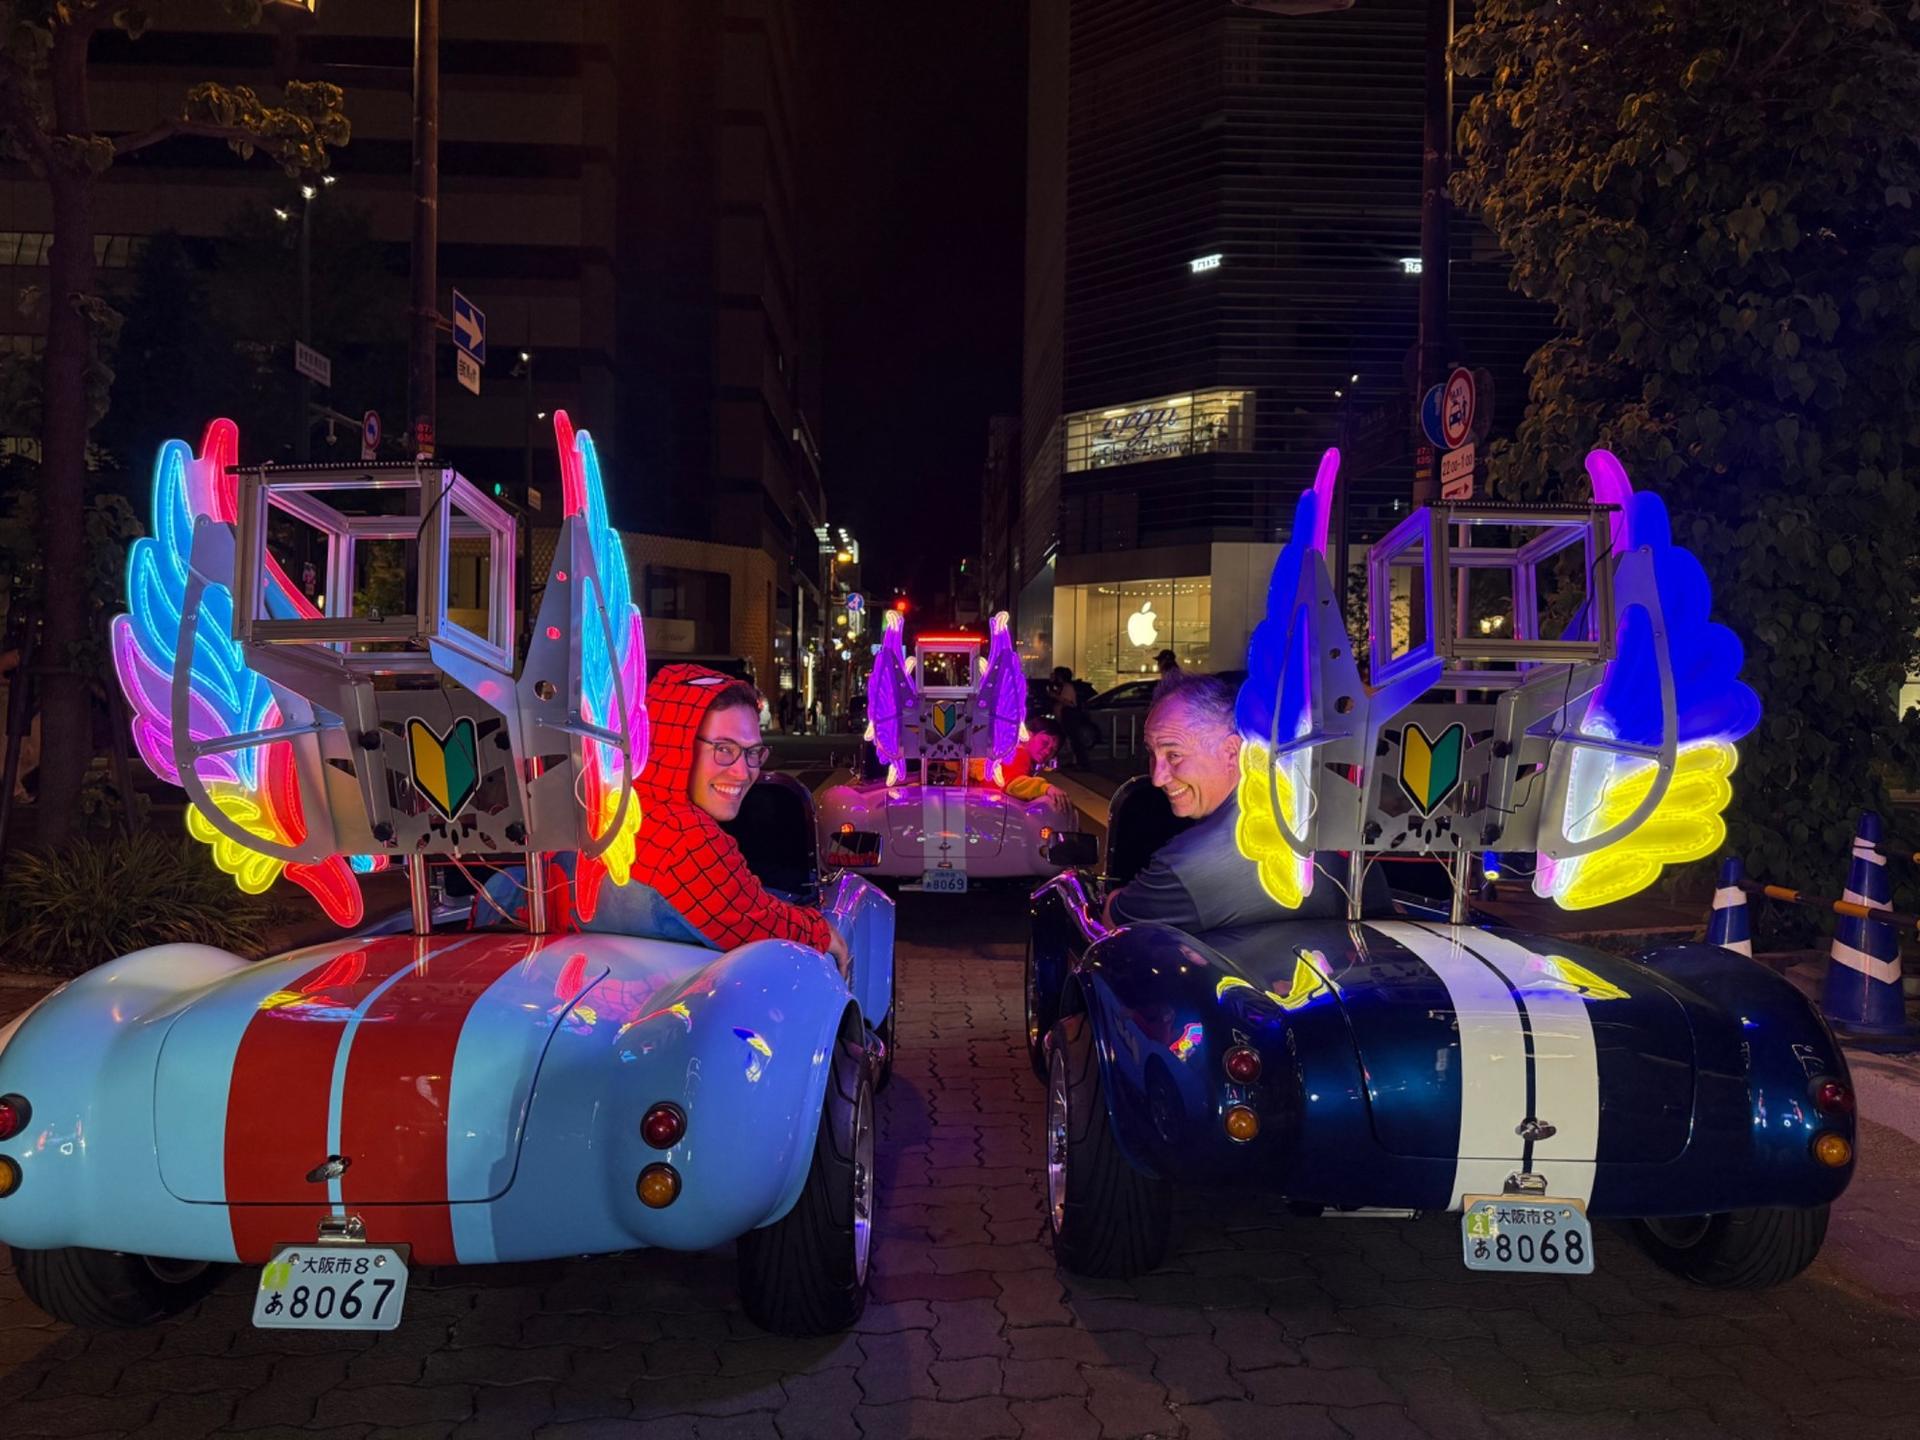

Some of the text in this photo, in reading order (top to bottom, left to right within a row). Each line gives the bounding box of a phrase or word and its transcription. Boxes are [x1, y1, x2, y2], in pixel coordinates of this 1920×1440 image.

[933, 879, 964, 890] 8069
[1474, 1229, 1584, 1265] あ 8068
[302, 1257, 369, 1275] 大阪市8
[265, 1278, 395, 1320] あ 8067
